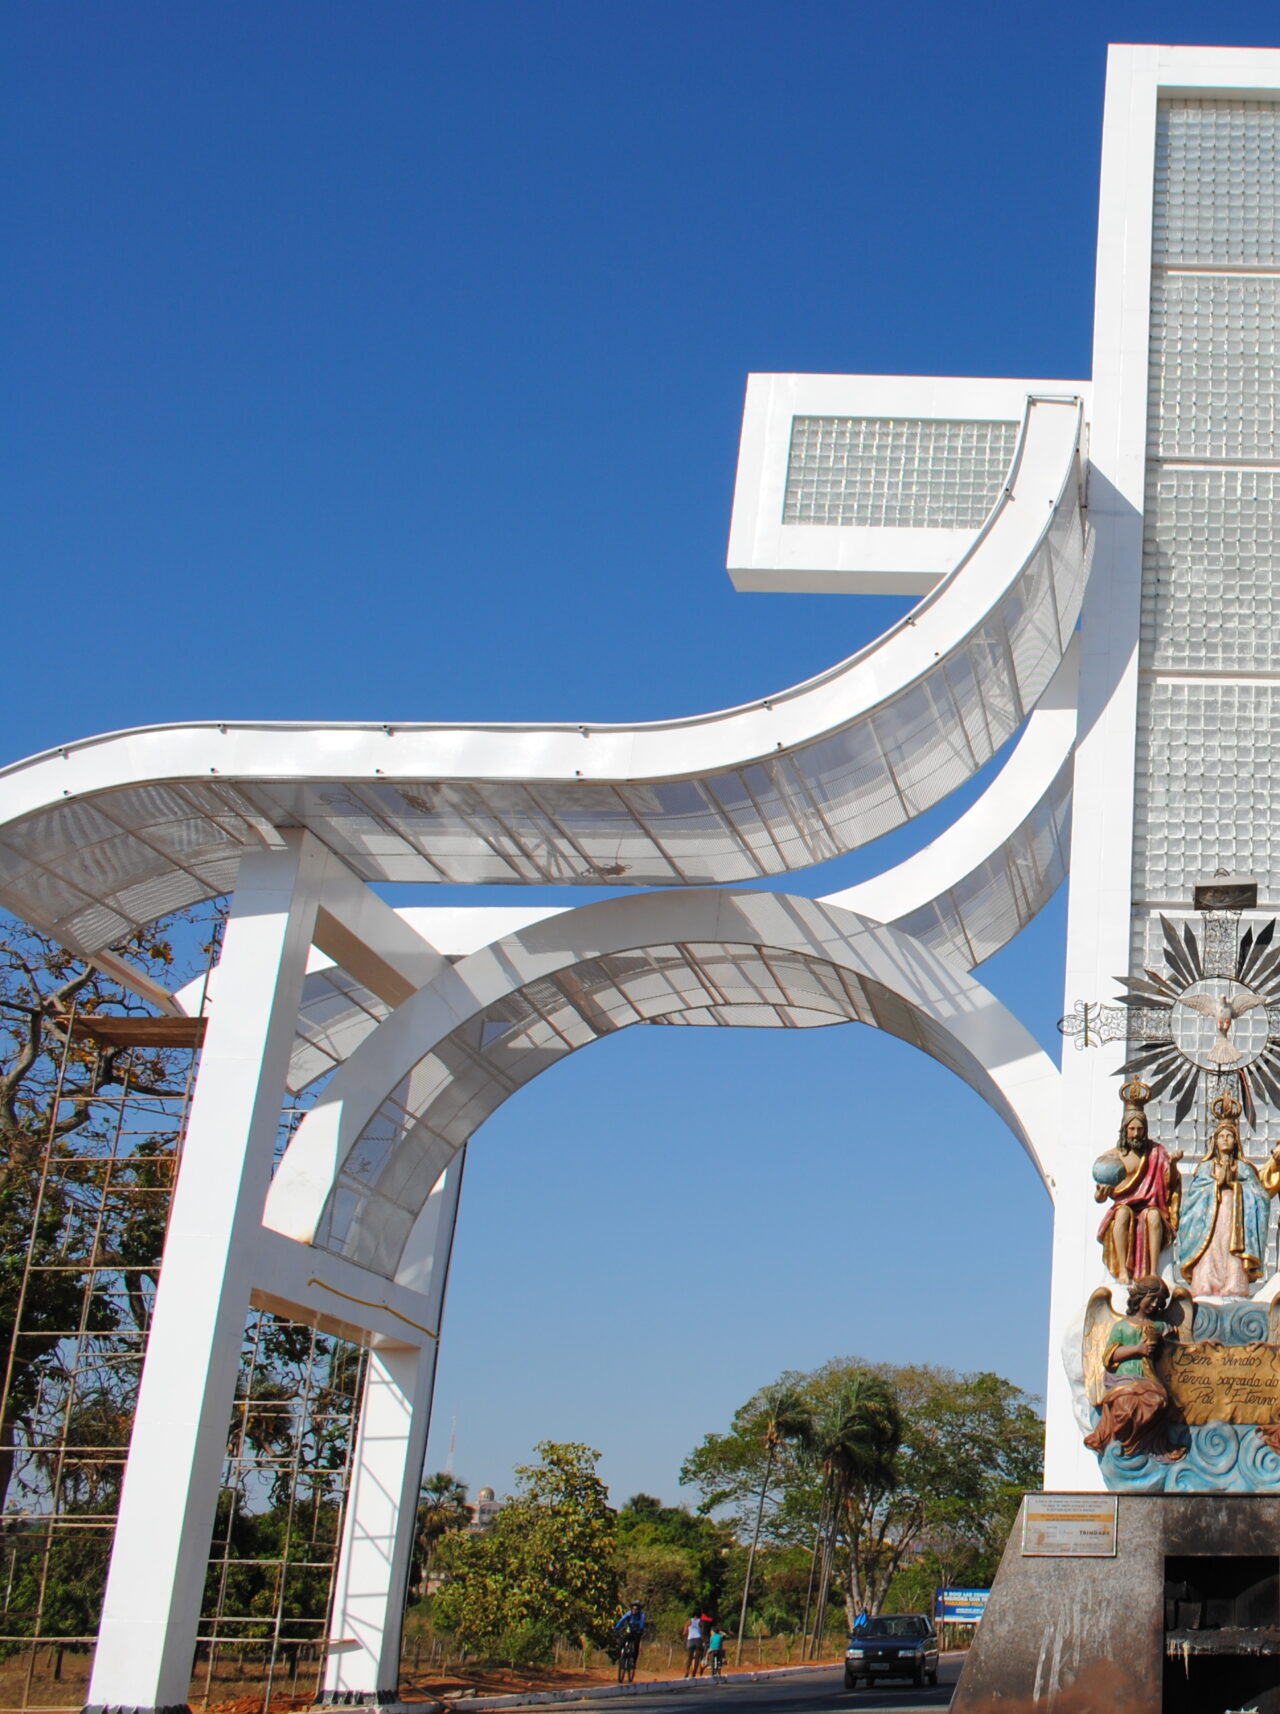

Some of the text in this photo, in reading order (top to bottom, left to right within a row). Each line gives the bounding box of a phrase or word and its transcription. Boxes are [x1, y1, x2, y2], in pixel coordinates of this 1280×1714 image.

[1175, 1347, 1212, 1366] Bem
[1178, 1369, 1212, 1385] terra
[1216, 1373, 1262, 1396] sagrada
[1265, 1374, 1280, 1388] do
[1189, 1386, 1215, 1405] Pai
